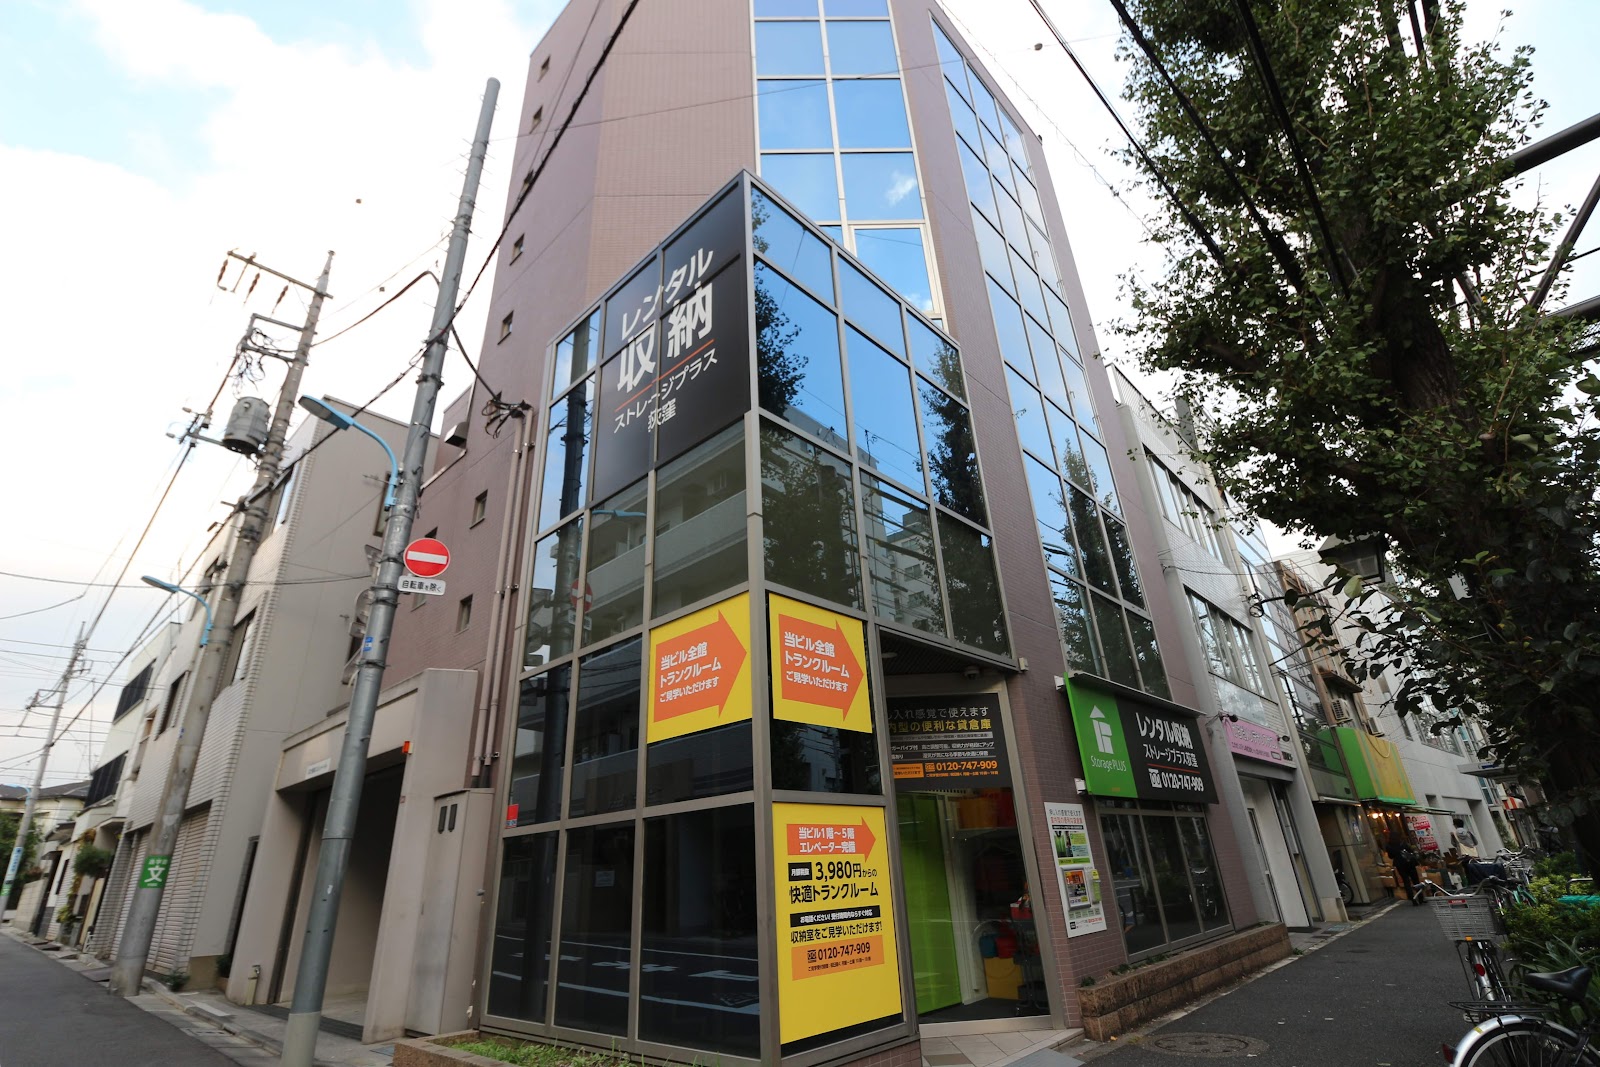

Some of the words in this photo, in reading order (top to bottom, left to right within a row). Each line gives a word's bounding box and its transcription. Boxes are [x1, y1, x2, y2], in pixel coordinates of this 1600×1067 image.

[622, 248, 714, 341] レンタル
[617, 281, 713, 393] 収納
[614, 348, 718, 434] ストレージプラス
[402, 580, 442, 592] 自転車を除く
[660, 641, 708, 671] 当ビル全館
[784, 631, 836, 658] 当ビル全館
[659, 657, 722, 689] トランクルーム
[784, 651, 850, 678] トランクルーム
[659, 676, 720, 703] ご見学いただけます
[785, 671, 849, 693] ご見学いただけます
[1135, 712, 1194, 750] レンタル収納
[936, 760, 998, 771] 0120-747-909
[1161, 772, 1205, 793] 0120-747-909
[799, 841, 856, 853] エレベーター完備
[144, 865, 166, 883] 文
[815, 860, 877, 882] 3,980円からの
[789, 882, 879, 905] 快適トランクルーム
[790, 921, 883, 944] 収納室をご見学いただけます!
[817, 942, 871, 961] 0120-747-909
